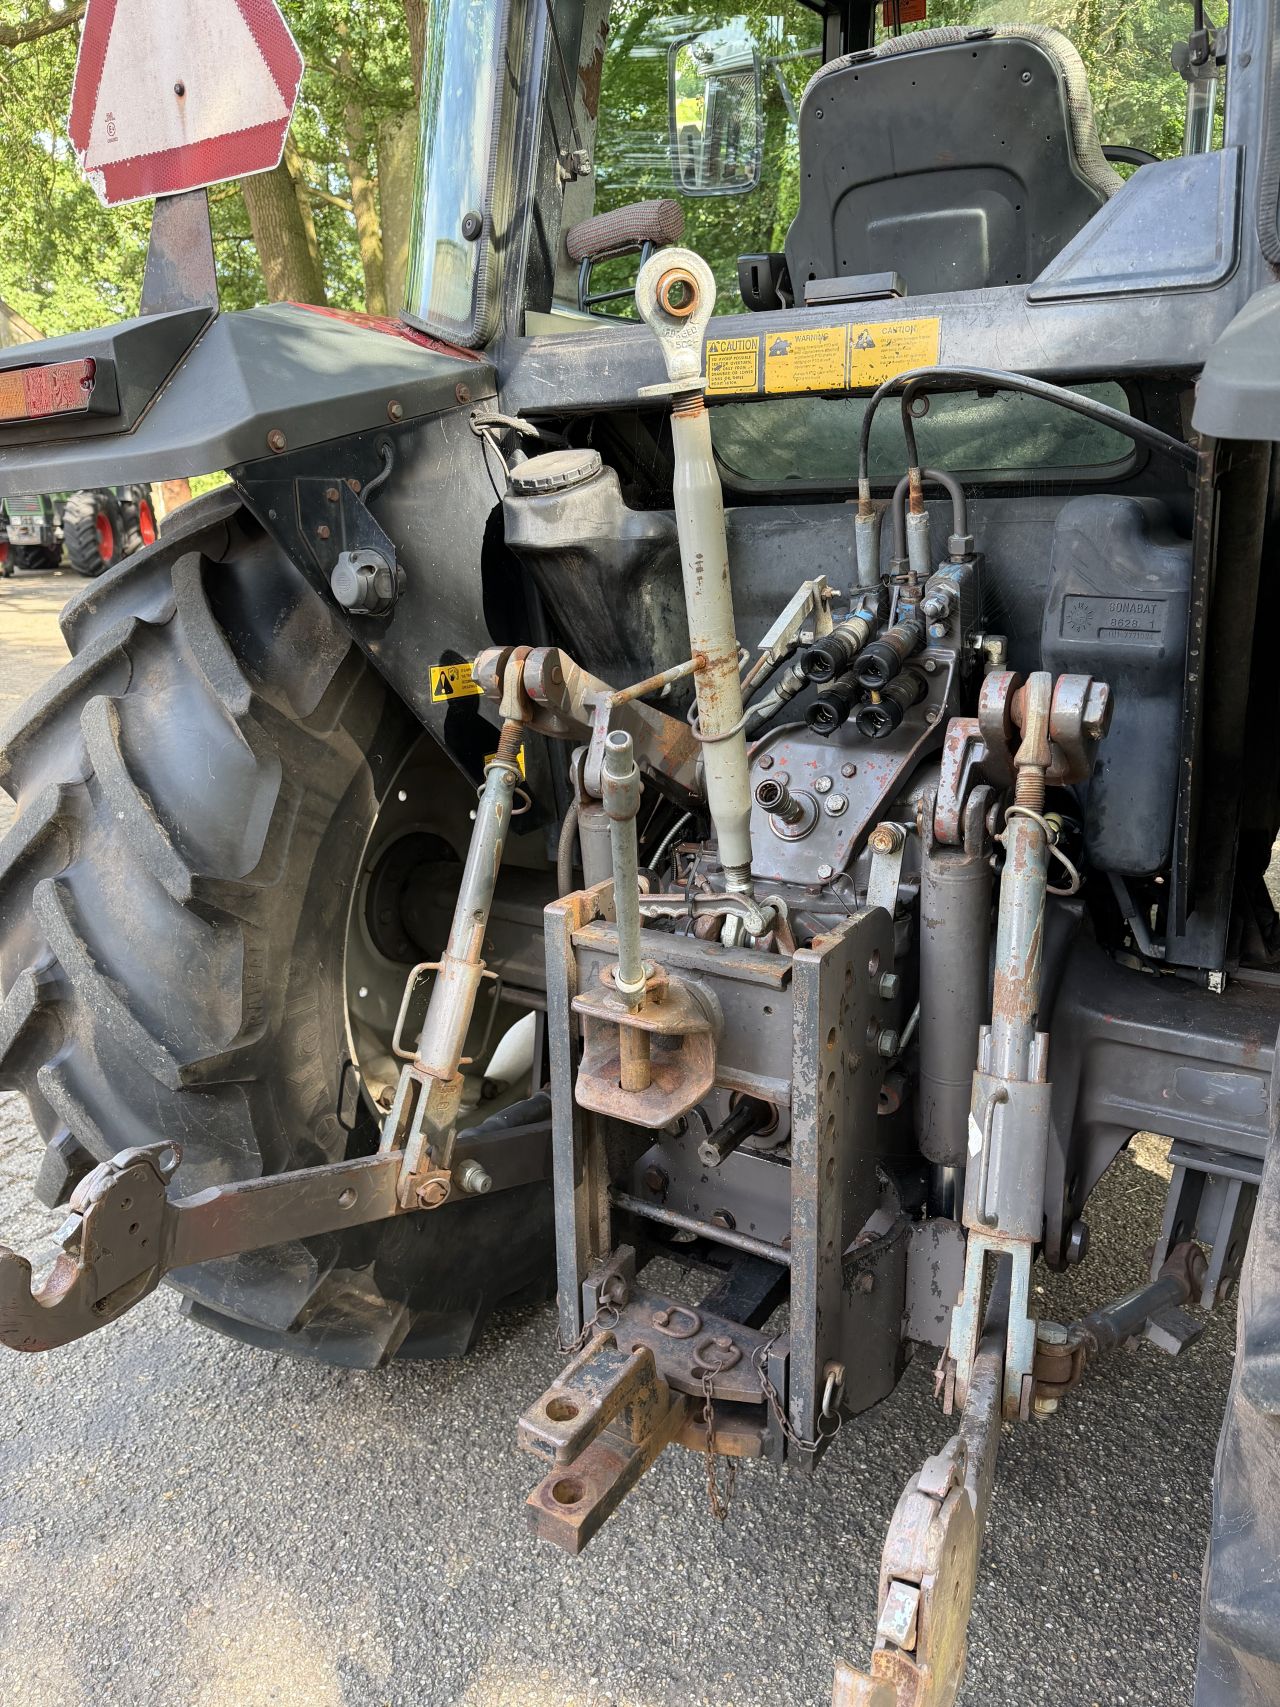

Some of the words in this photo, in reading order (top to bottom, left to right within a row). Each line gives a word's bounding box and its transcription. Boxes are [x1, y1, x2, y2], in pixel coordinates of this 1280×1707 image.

[881, 325, 917, 334] CAUTION
[794, 332, 829, 342] WARNING
[720, 339, 758, 352] CAUTION
[1109, 602, 1158, 614] SONABAT
